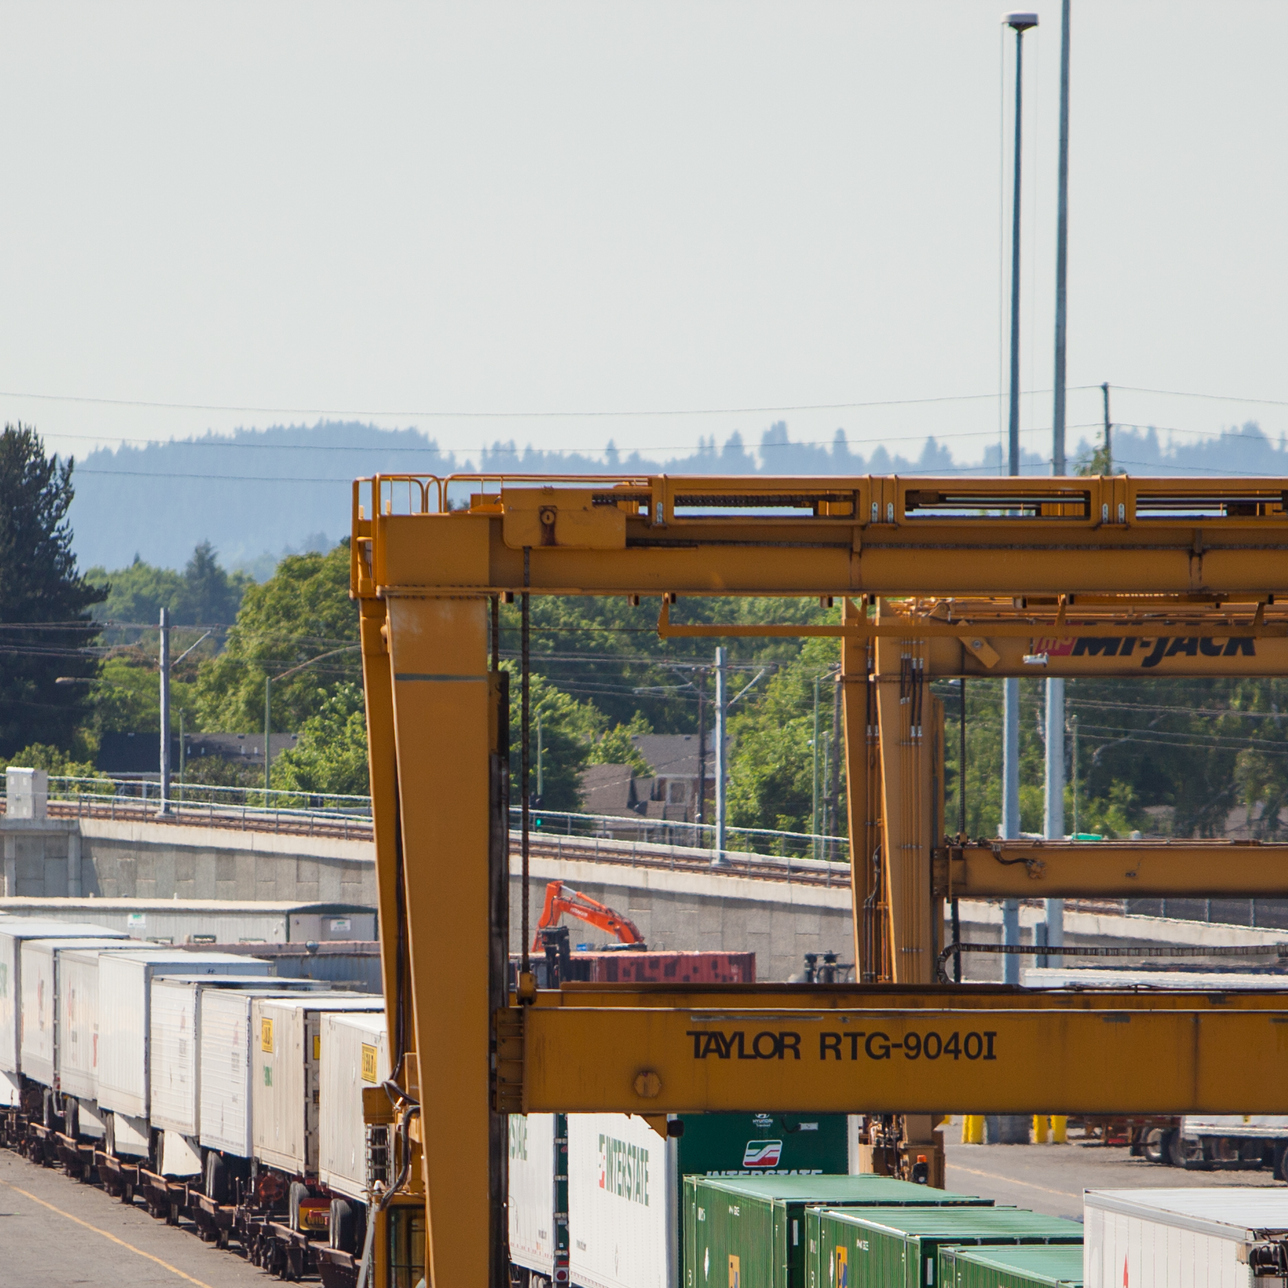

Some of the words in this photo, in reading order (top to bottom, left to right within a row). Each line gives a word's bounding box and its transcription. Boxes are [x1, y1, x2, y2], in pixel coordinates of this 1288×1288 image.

[1071, 622, 1257, 668] MI-JACK
[686, 1031, 801, 1060] TAYLOR
[819, 1031, 997, 1061] RTG-9040I
[606, 1135, 649, 1207] INTERSTATE
